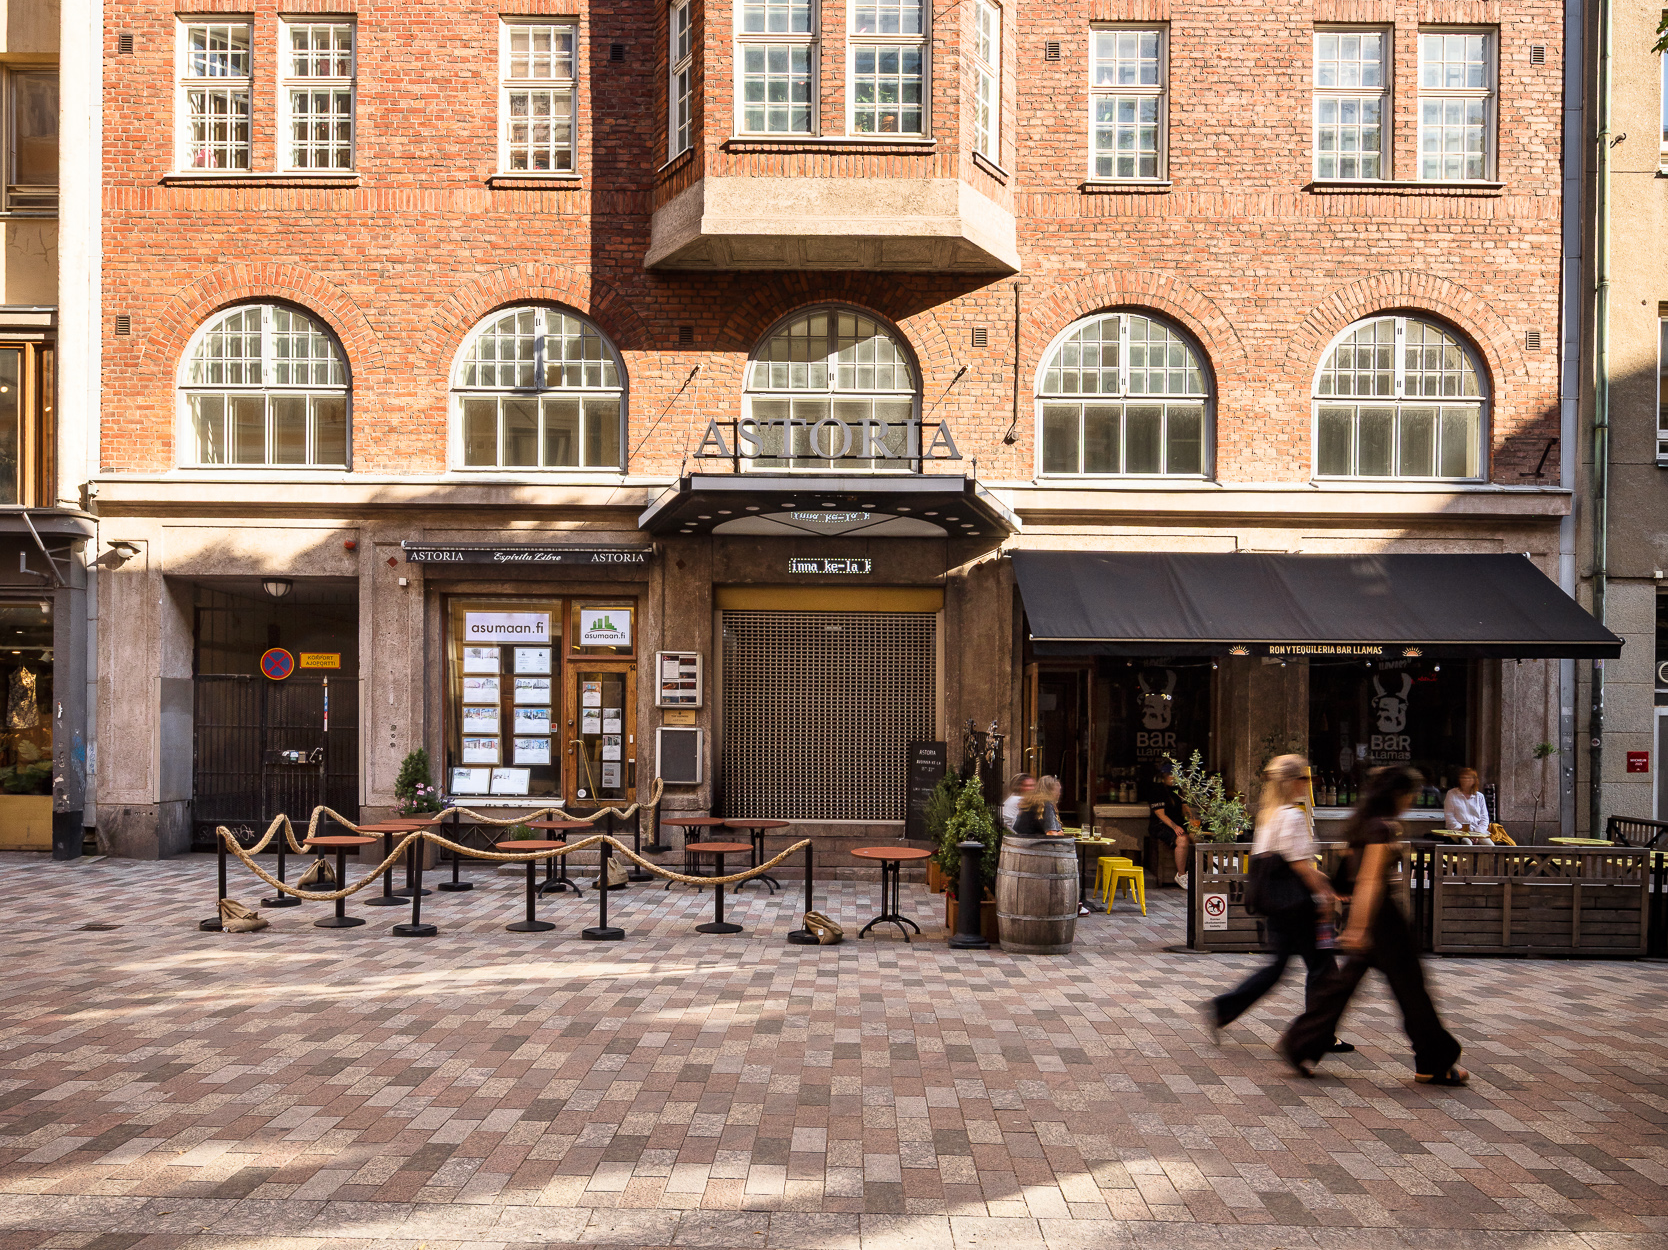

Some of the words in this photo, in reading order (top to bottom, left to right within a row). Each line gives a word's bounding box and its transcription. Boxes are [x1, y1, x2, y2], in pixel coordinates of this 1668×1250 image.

[693, 417, 963, 460] ASTORIA
[410, 551, 464, 561] ASTORIA
[533, 552, 562, 562] Libre
[591, 553, 645, 562] ASTORIA
[792, 559, 818, 572] inna
[824, 560, 858, 572] ke-la
[471, 621, 544, 634] asumaan.fi
[584, 631, 626, 639] asumaan.fi
[1269, 645, 1286, 654] RON
[1292, 645, 1336, 655] TEQUILERIA
[1336, 645, 1352, 654] BAR
[1353, 646, 1383, 655] LLAMAS
